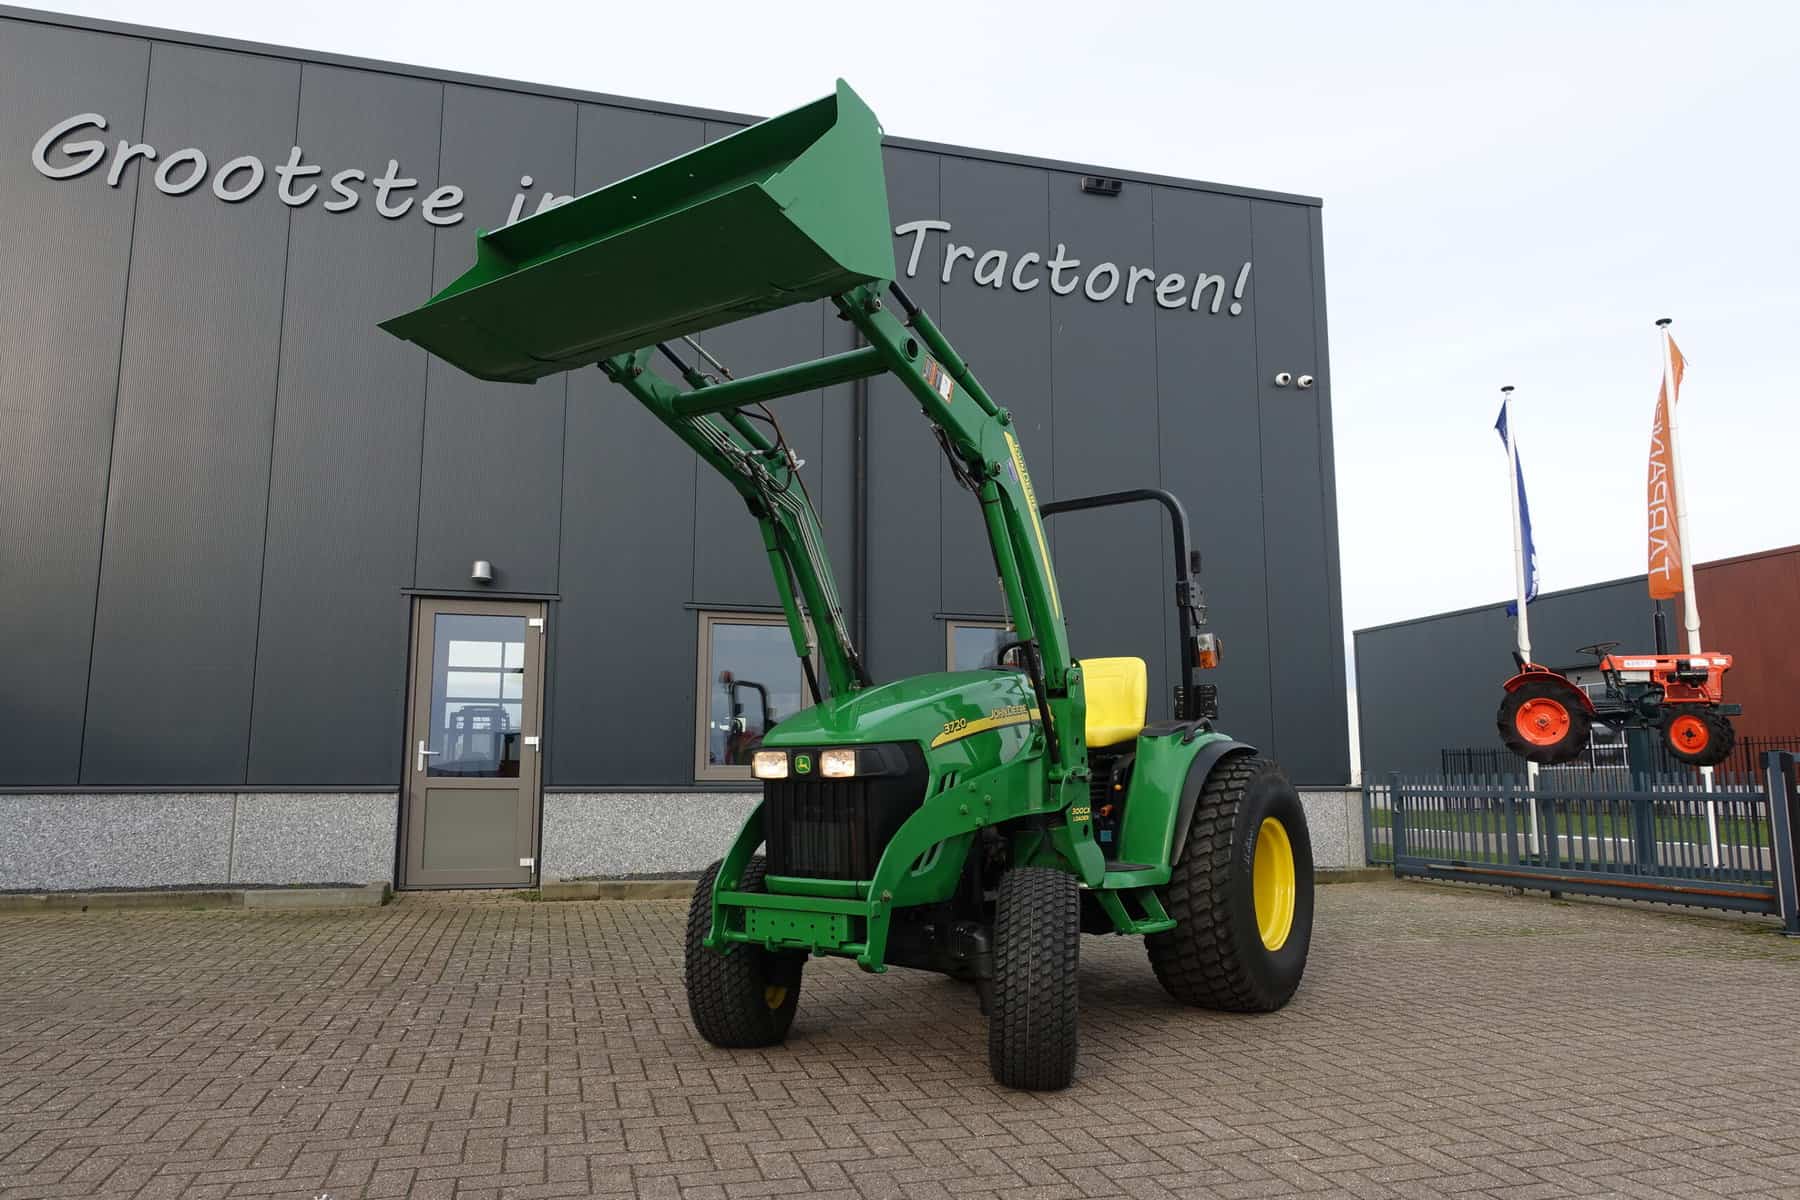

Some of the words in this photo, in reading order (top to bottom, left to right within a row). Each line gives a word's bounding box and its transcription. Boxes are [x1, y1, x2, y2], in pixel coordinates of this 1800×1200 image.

[31, 112, 465, 227] Grootste
[895, 219, 1252, 316] Tractoren!
[943, 717, 967, 735] 3720
